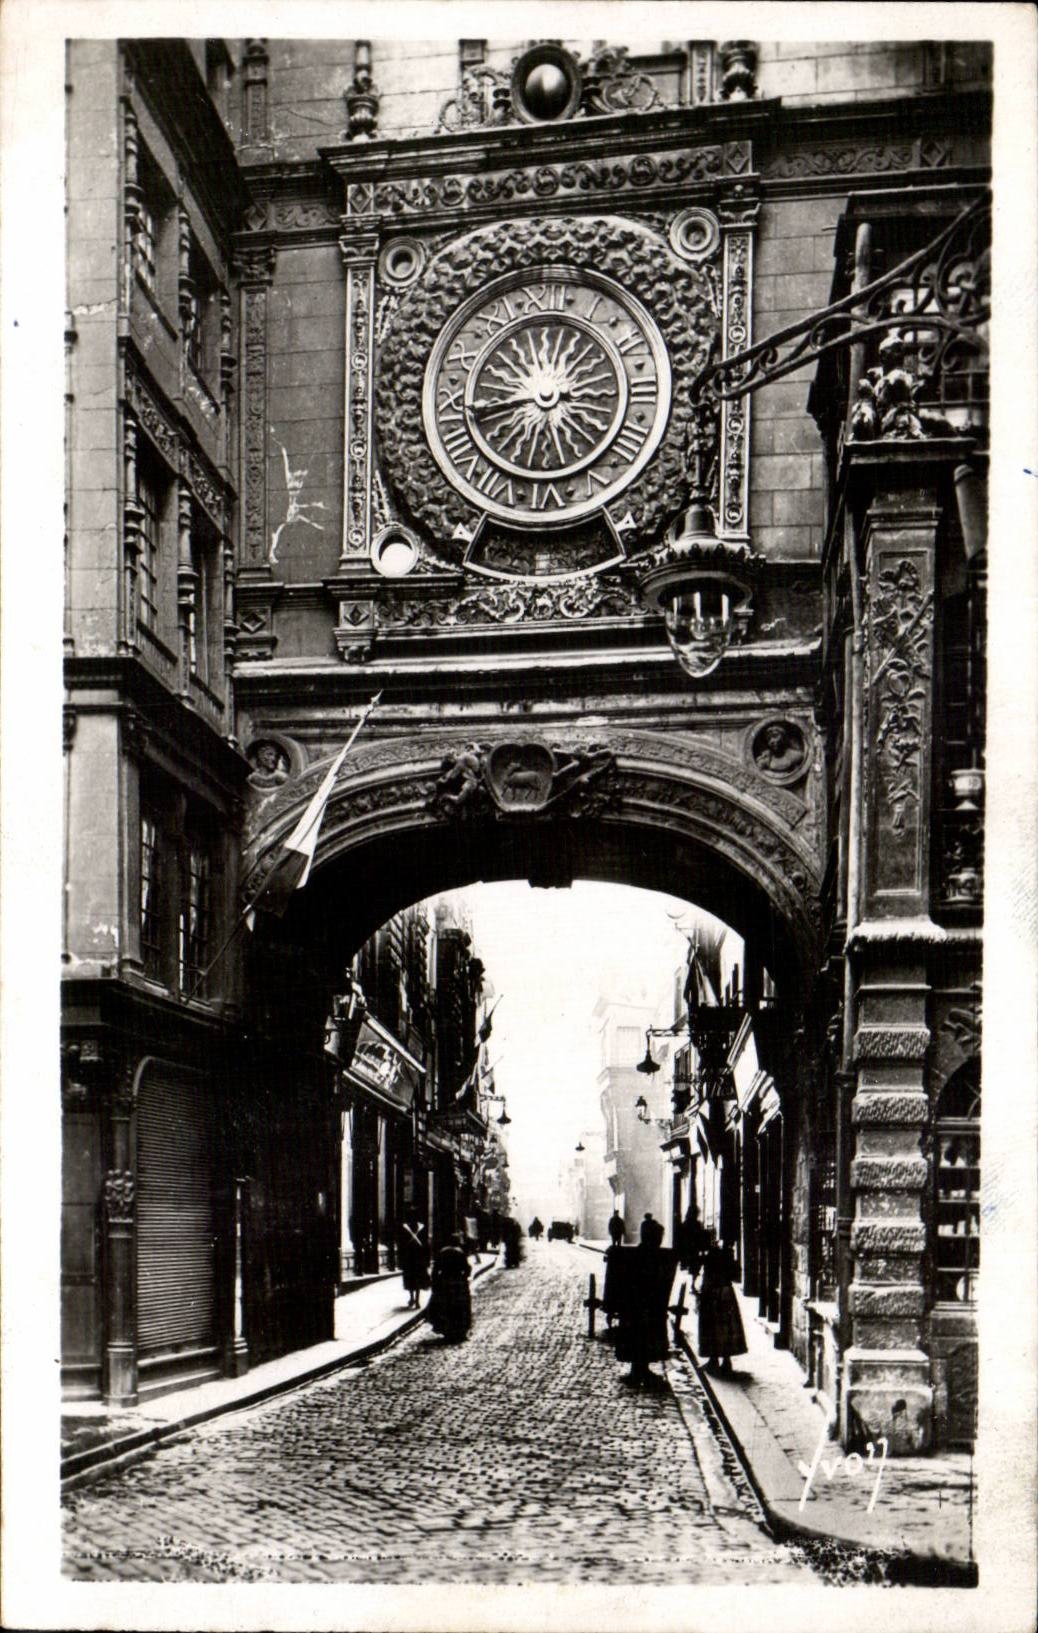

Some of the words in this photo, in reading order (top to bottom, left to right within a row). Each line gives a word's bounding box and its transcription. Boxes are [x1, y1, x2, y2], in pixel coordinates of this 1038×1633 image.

[522, 285, 565, 314] XII
[476, 296, 516, 336] XI
[448, 340, 479, 371] X
[631, 376, 657, 403] III
[439, 388, 464, 422] IX
[612, 420, 649, 462] IIII
[531, 483, 566, 509] VI
[586, 470, 611, 496] V
